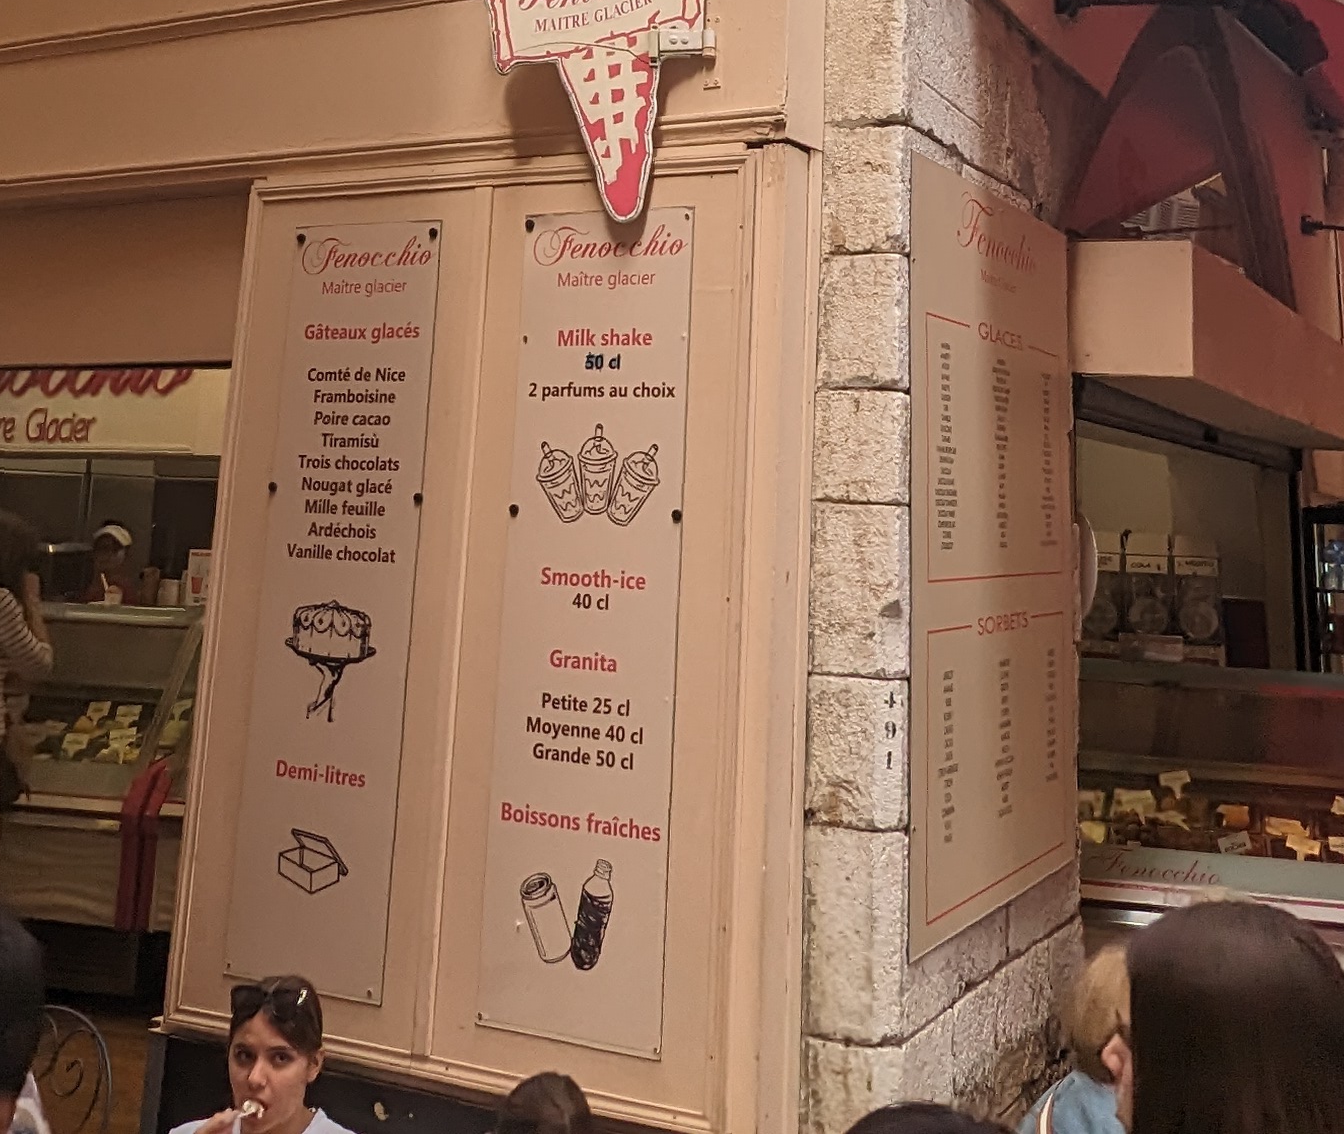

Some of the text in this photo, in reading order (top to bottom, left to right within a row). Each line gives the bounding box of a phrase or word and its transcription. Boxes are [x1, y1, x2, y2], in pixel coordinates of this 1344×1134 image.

[534, 10, 590, 34] MAITRE
[301, 235, 433, 275] Fenocchio
[533, 223, 690, 267] Fenocchio
[364, 279, 408, 298] glacier
[557, 270, 657, 291] Maître glacier
[304, 321, 421, 345] Gâteaux glacés
[557, 328, 654, 348] Milk shake
[978, 321, 1024, 351] GLACES
[608, 353, 622, 371] cl
[307, 366, 407, 383] Comté de Nice
[313, 388, 397, 405] Framboisine
[528, 381, 677, 401] 2 parfums au choix
[25, 406, 98, 445] Glacier
[313, 411, 392, 428] Poire cacao
[298, 454, 401, 473] Trois chocolats
[301, 476, 393, 499] Nougat glacé
[304, 498, 387, 518] Mille feuille
[307, 521, 378, 540] Ardéchois
[286, 543, 397, 565] Vanille chocolat
[540, 566, 647, 591] Smooth-ice
[571, 592, 610, 612] 40 cl
[977, 611, 1029, 636] SORBETS
[549, 649, 619, 674] Granita
[540, 691, 631, 718] Petite 25 cl
[525, 716, 645, 746] Moyenne 40 cl
[531, 743, 635, 772] Grande 50 cl
[275, 759, 367, 788] Demi-litres
[500, 801, 662, 843] Boissons fraîches
[1087, 846, 1221, 886] Fenocchio
